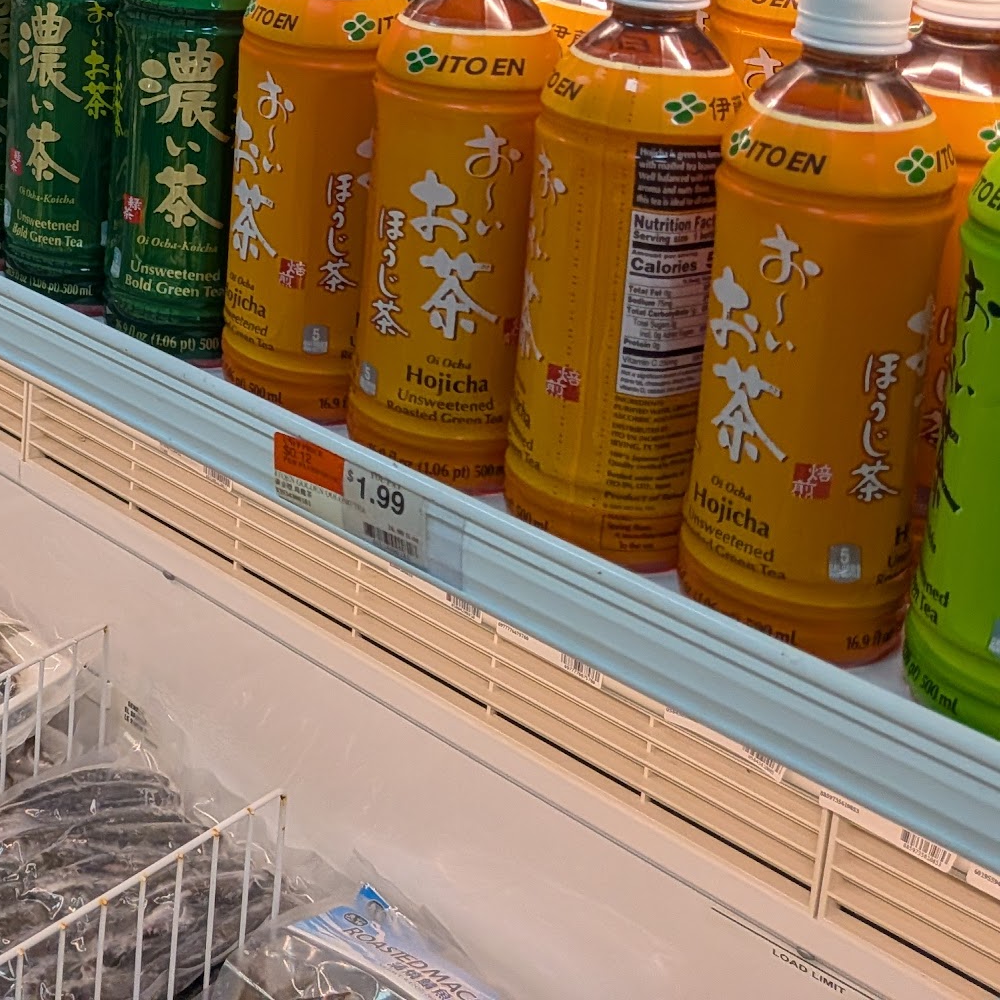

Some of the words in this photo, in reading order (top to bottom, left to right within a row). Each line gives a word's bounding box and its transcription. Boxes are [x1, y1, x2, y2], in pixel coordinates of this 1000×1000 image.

[252, 5, 275, 25] ITO
[273, 13, 299, 32] EN
[436, 54, 488, 75] ITO
[491, 57, 526, 76] EN
[18, 2, 84, 182] 濃い茶
[556, 78, 584, 101] EN
[137, 37, 231, 230] 濃い茶
[747, 140, 787, 167] ITO
[787, 151, 827, 176] EN
[16, 208, 80, 232] Unsweetened
[319, 172, 357, 293] ほうじ茶
[634, 213, 692, 232] Nutrition
[12, 223, 28, 239] Bold
[29, 230, 63, 247] Green
[64, 236, 83, 248] Tea
[136, 234, 149, 246] Oi
[633, 230, 671, 246] Serving
[408, 169, 500, 340] お茶
[630, 257, 698, 275] Calories
[130, 257, 220, 282] Unsweetened
[371, 207, 410, 336] ほうじ茶
[125, 273, 152, 291] Bold
[155, 281, 199, 298] Green
[204, 286, 224, 298] Tea
[426, 354, 439, 366] Oi
[442, 357, 472, 370] Ocha
[708, 265, 788, 464] お茶
[405, 364, 489, 396] Hojicha
[386, 400, 437, 423] Roasted
[441, 412, 482, 425] Green
[398, 387, 494, 412] Unsweetened
[849, 352, 900, 503] ほうじ茶
[710, 474, 723, 487] Oi
[724, 478, 752, 502] Ocha
[692, 481, 771, 540] Hojicha
[688, 504, 775, 563] Unsweetened
[760, 562, 786, 581] Tea
[342, 926, 428, 971] ROASTED
[771, 947, 809, 975] LOAD
[811, 967, 847, 995] LIMIT
